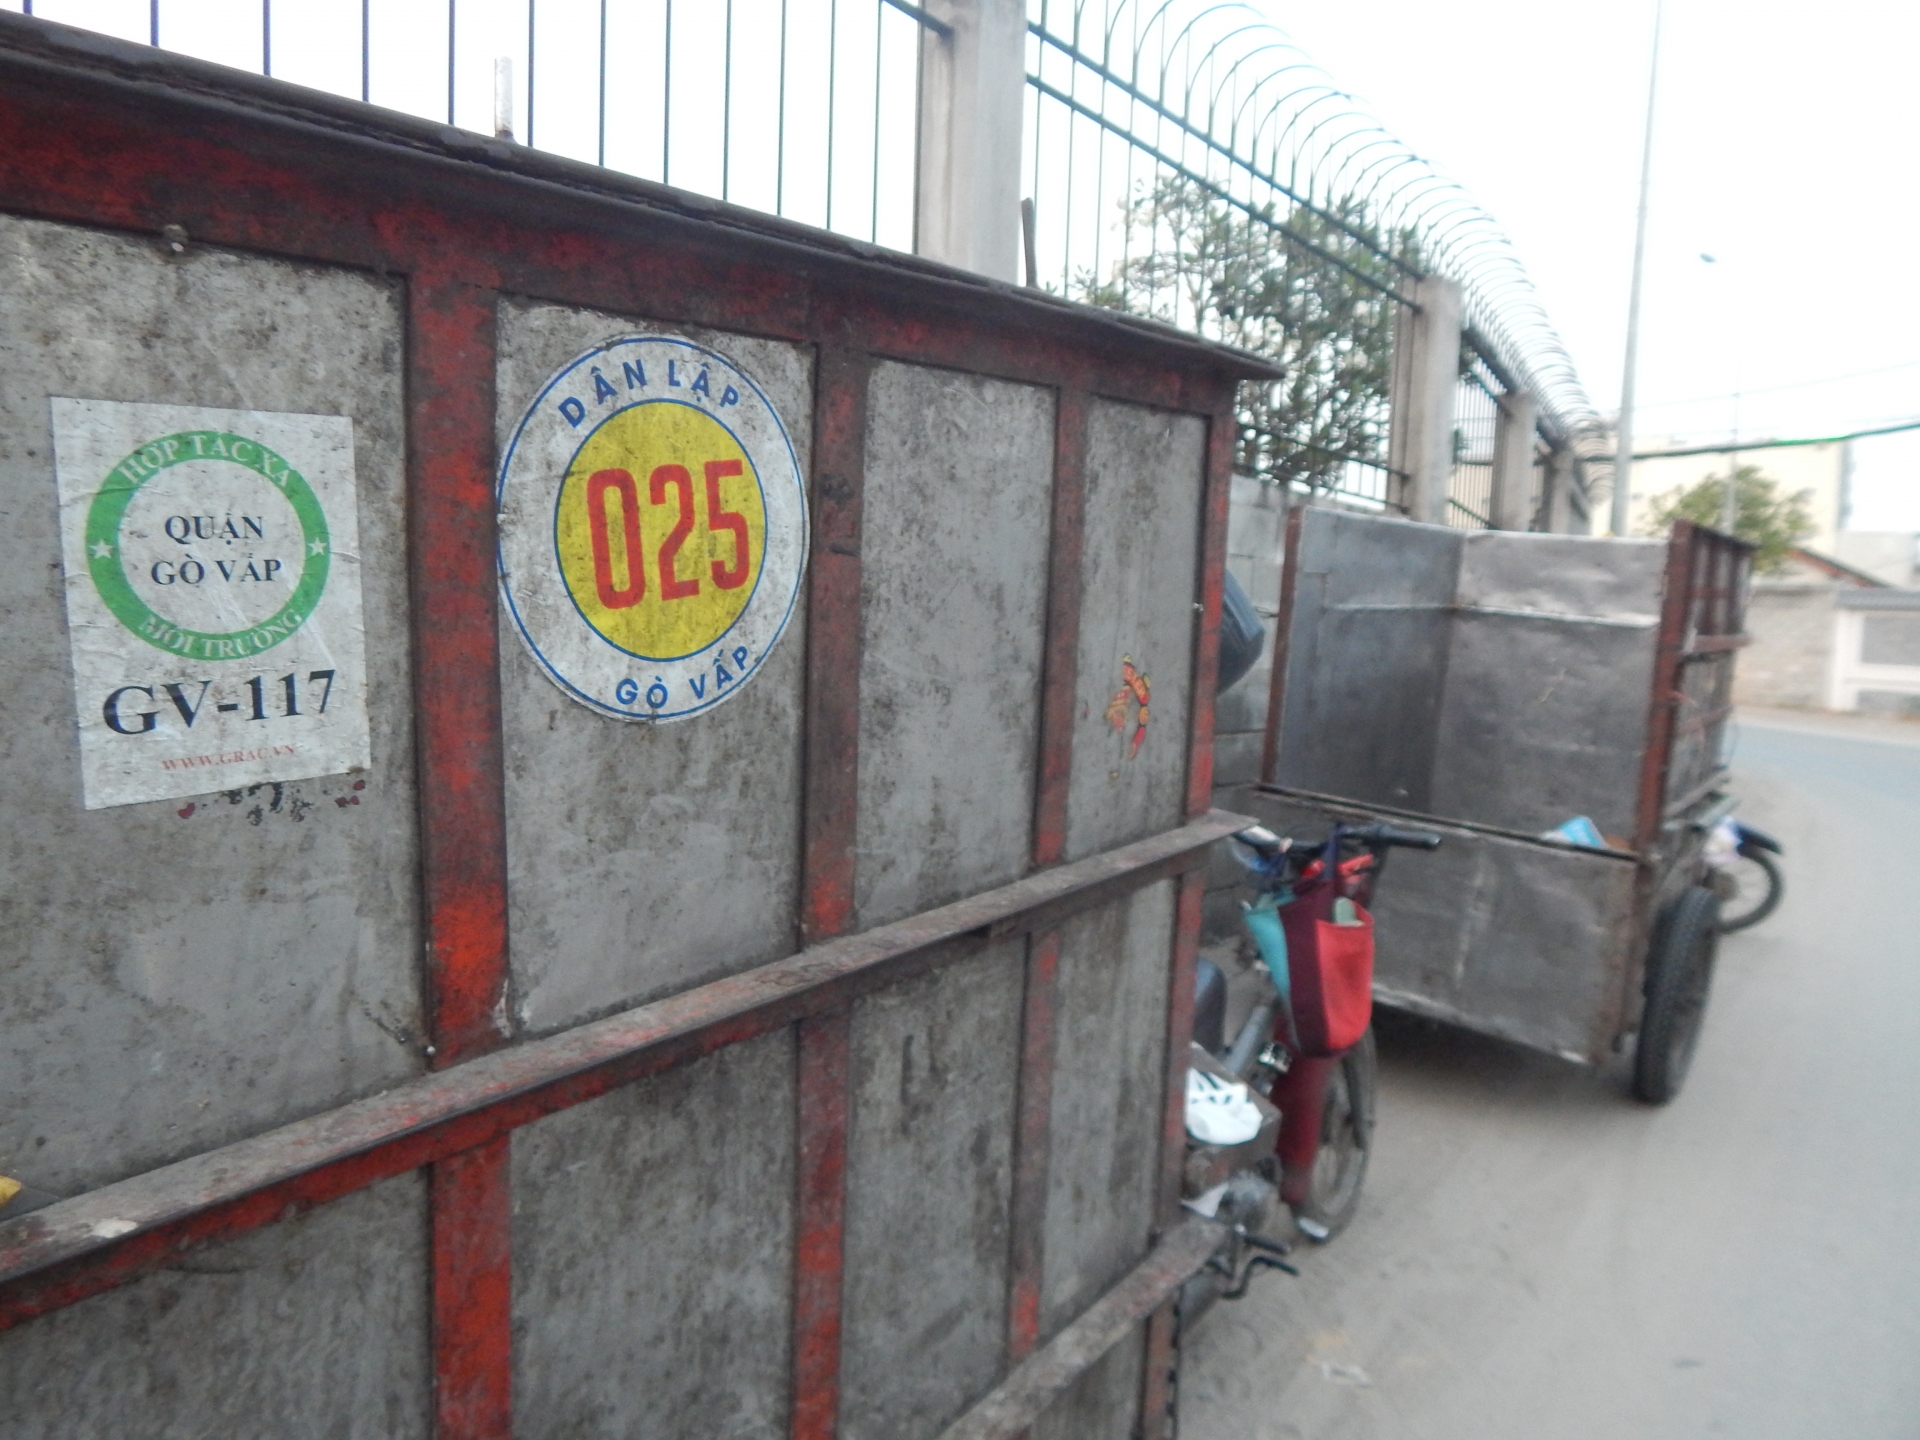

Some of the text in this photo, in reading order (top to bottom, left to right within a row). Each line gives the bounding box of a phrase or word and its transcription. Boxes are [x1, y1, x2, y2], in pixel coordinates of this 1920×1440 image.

[558, 359, 739, 428] DÂN LẬP
[164, 512, 264, 545] QUẬN
[586, 458, 750, 610] 025
[151, 553, 205, 586] GÒ
[103, 669, 336, 735] GV-117
[615, 645, 748, 709] GÒ VẤP
